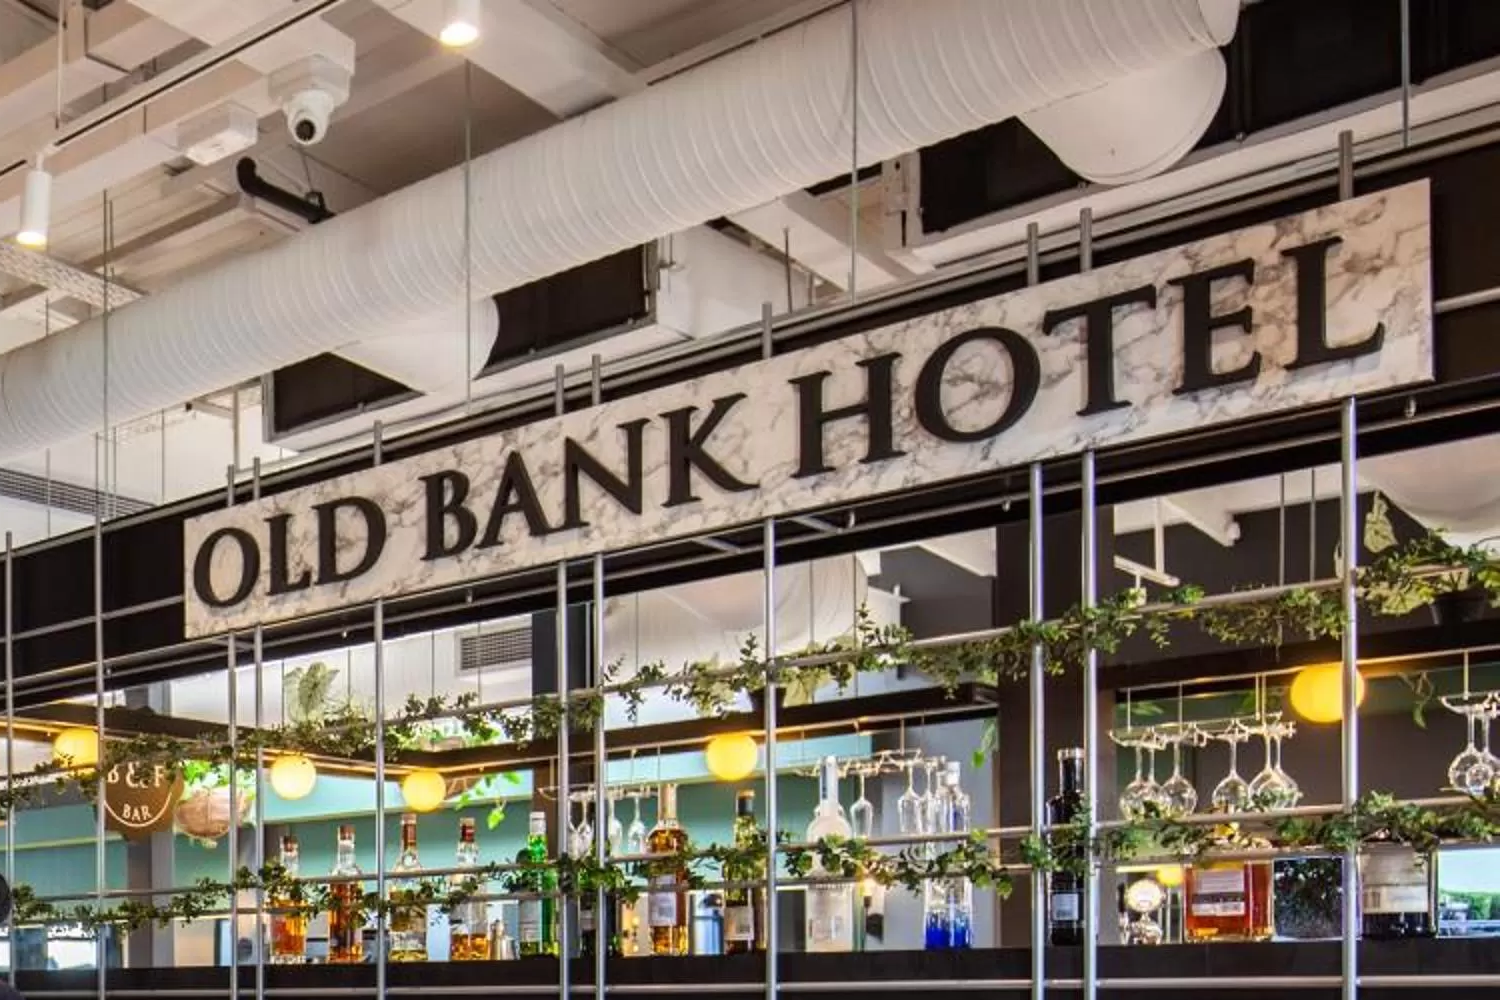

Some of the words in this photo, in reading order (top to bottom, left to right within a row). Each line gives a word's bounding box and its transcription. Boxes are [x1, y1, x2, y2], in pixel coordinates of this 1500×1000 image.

[193, 496, 387, 608] OLD
[418, 392, 761, 562] BANK
[787, 235, 1385, 479] HOTEL
[121, 803, 153, 822] BAR
